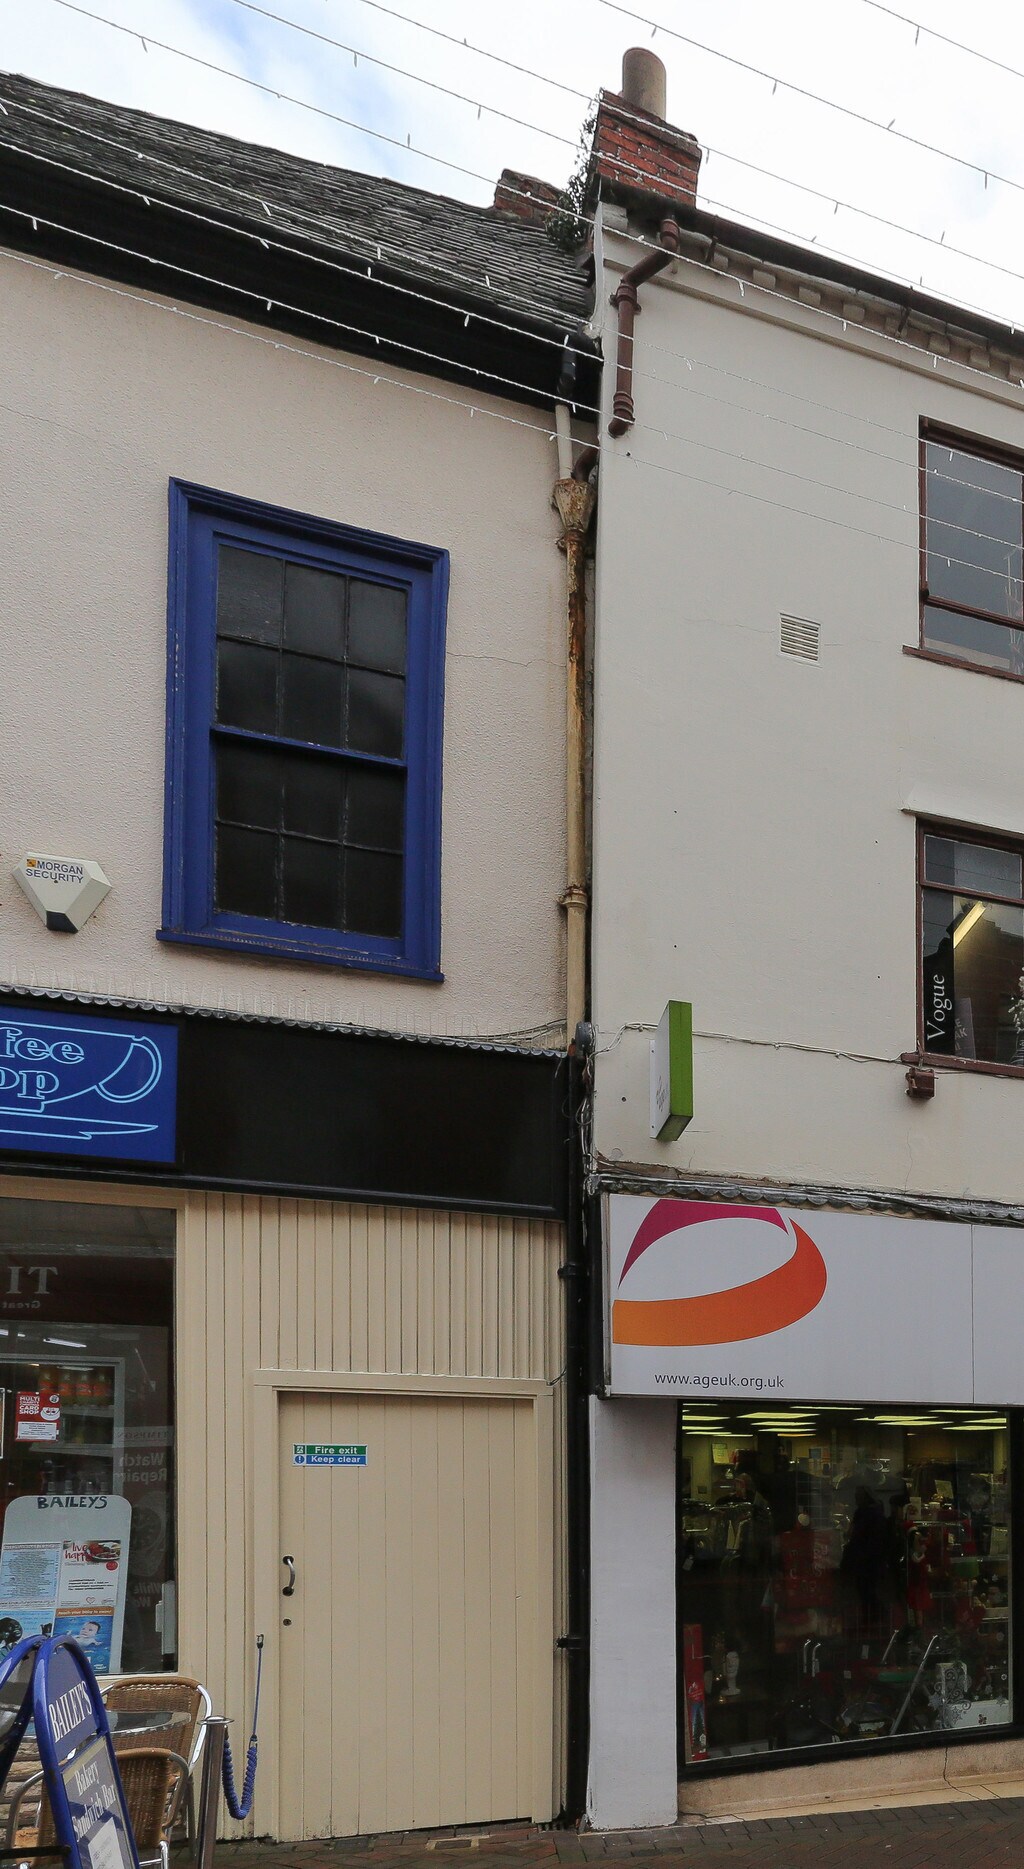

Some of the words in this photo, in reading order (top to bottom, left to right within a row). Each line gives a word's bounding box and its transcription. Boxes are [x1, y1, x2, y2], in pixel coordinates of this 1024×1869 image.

[37, 860, 83, 875] MORGAN
[25, 868, 84, 884] SECURITY
[927, 974, 952, 1040] Vogue
[655, 1372, 784, 1391] www.ageuk.org.uk
[315, 1446, 335, 1455] Fire
[339, 1446, 357, 1455] exit
[311, 1455, 335, 1464] Keep
[338, 1455, 361, 1463] clear
[37, 1496, 108, 1510] BAILEYS
[74, 1760, 99, 1797] Bakery
[72, 1792, 104, 1842] Sandwich
[102, 1783, 117, 1808] Bar
